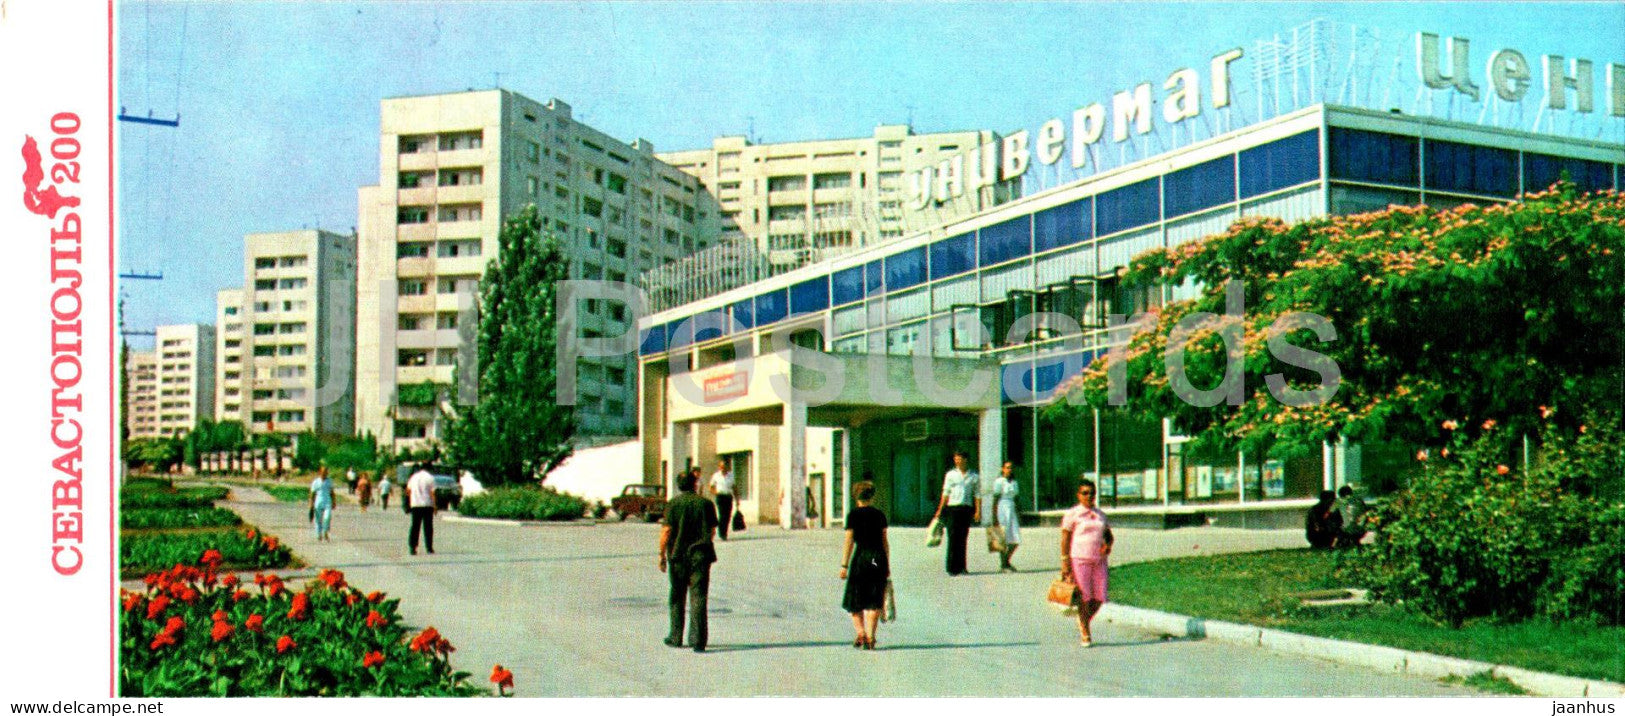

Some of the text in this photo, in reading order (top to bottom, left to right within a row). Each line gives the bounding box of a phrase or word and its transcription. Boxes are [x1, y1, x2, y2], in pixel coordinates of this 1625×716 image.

[909, 47, 1243, 211] универмаг
[51, 112, 83, 576] СЕВАСТОПОЛЬ 200
